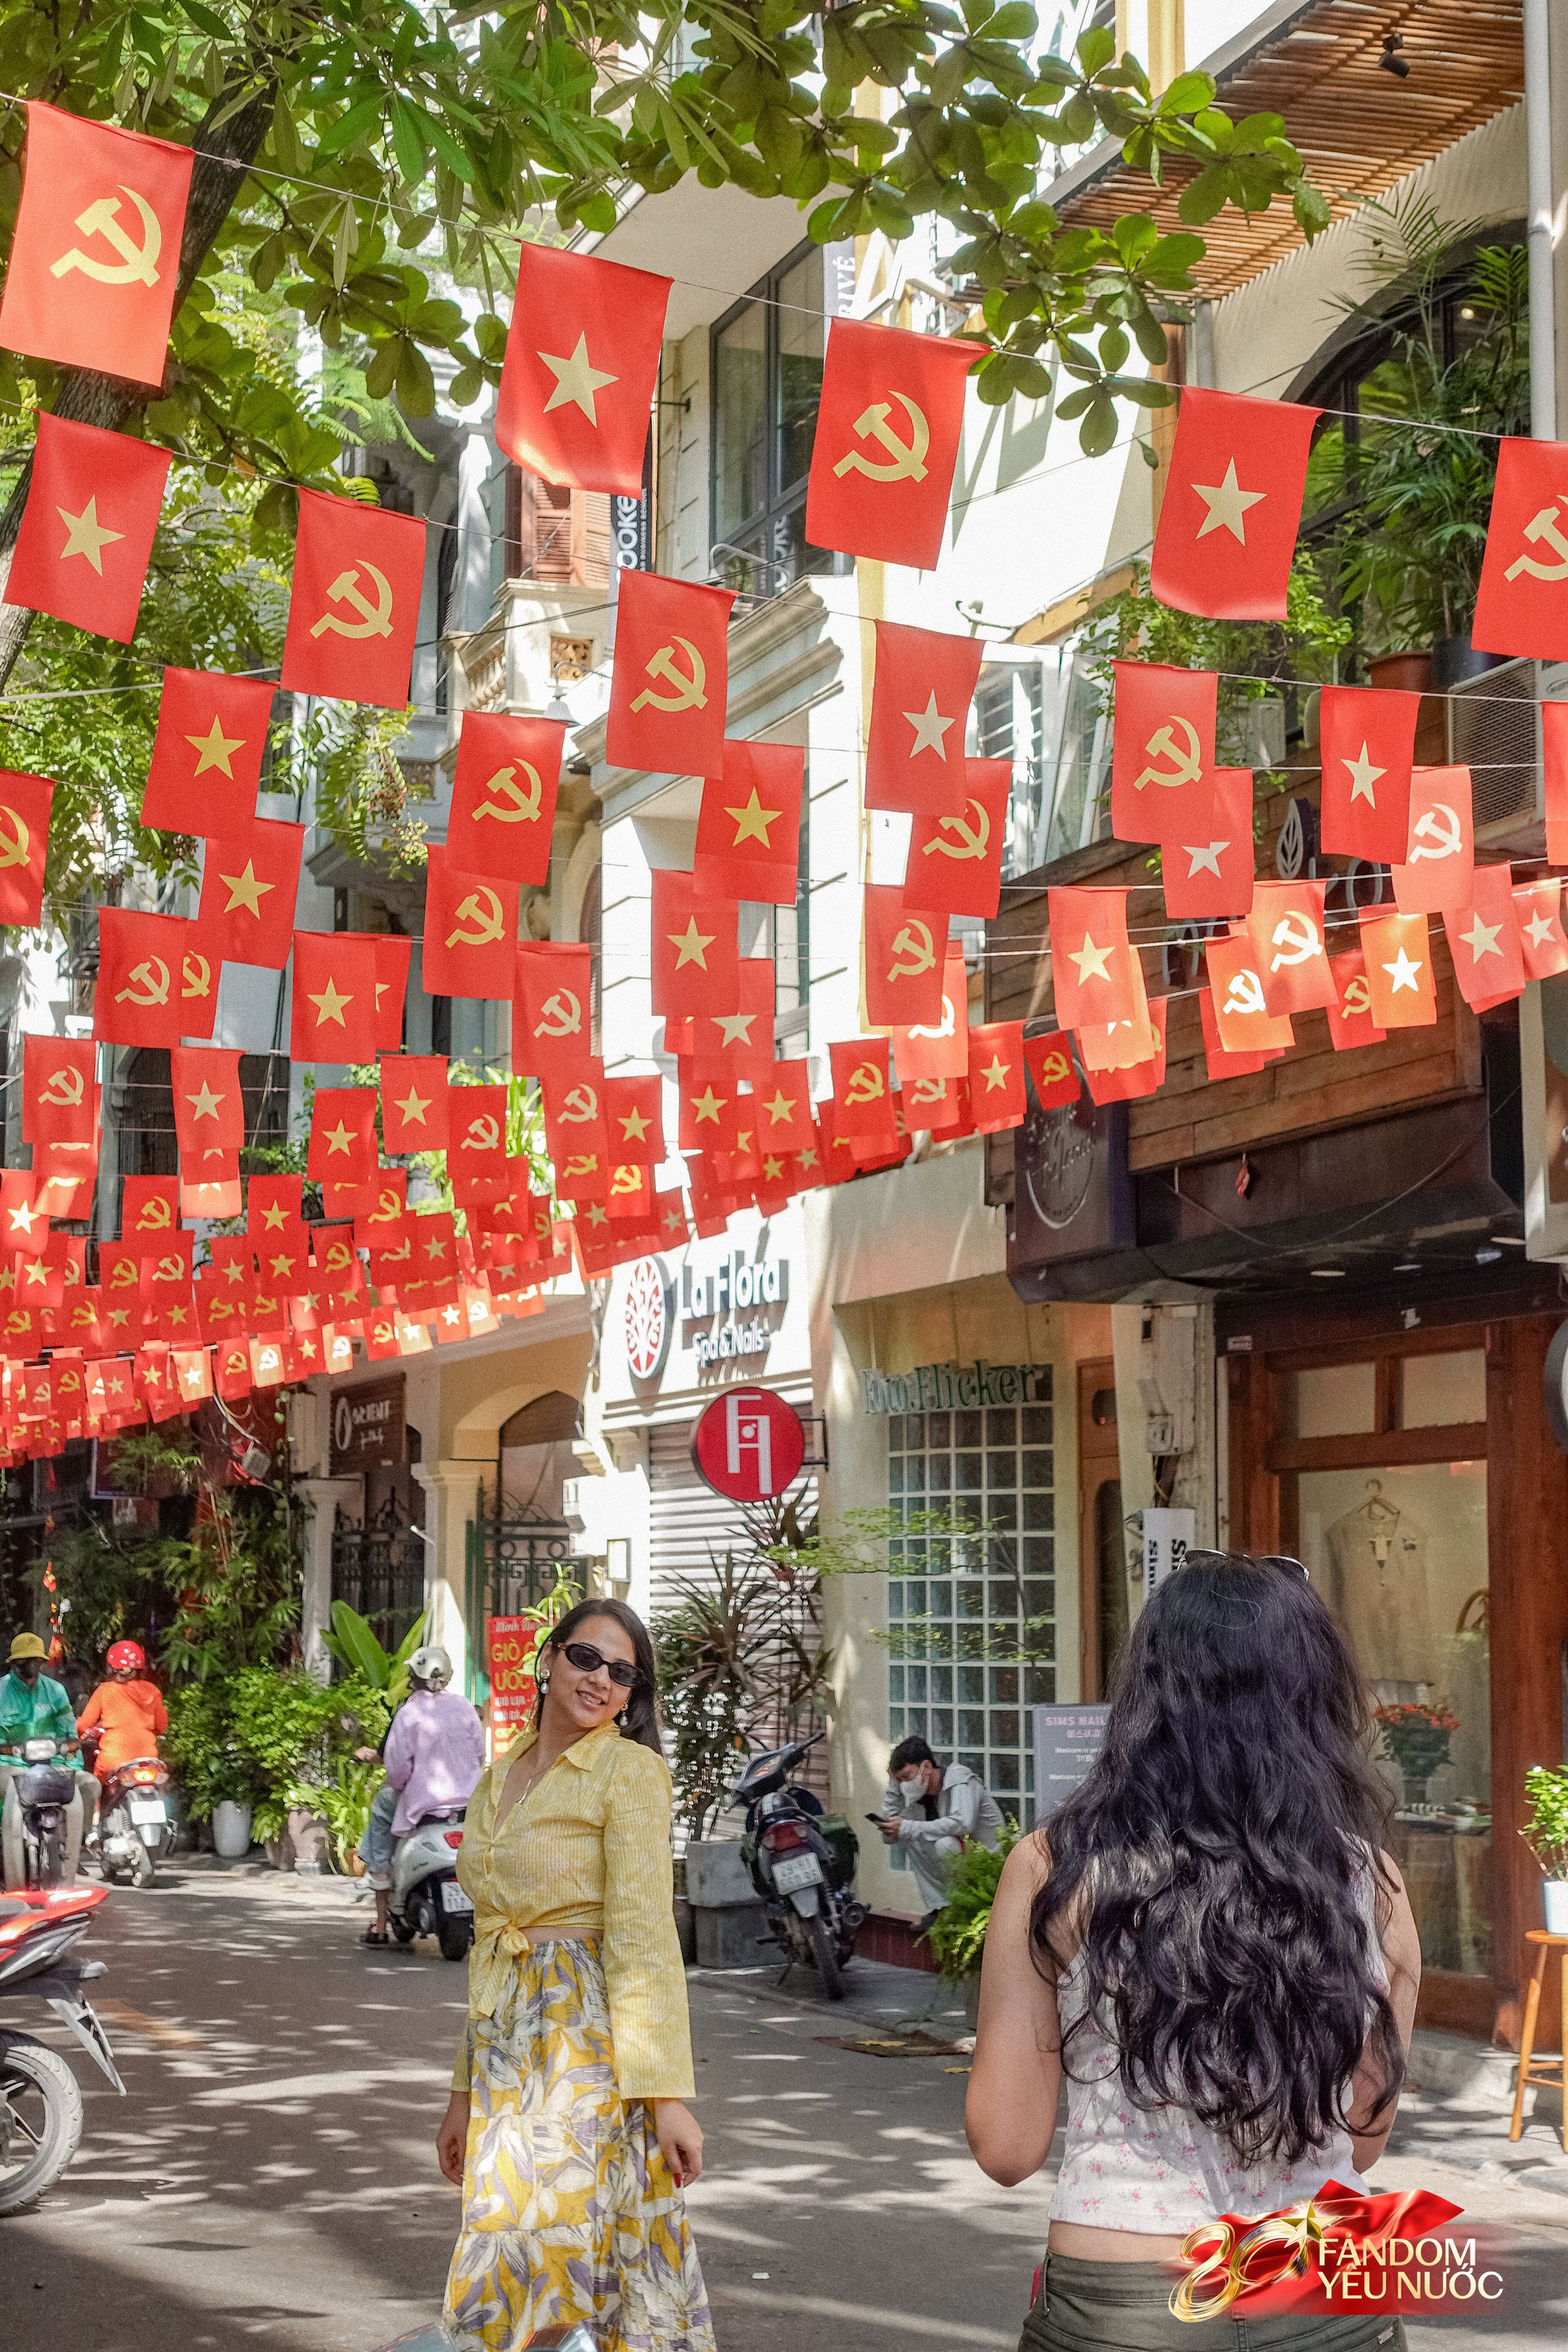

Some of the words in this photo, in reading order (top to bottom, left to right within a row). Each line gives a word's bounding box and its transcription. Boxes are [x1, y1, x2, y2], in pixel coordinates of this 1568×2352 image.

[676, 1262, 708, 1320] La
[713, 1251, 781, 1314] Flora
[692, 1330, 719, 1368] Spa
[731, 1319, 764, 1356] Nails
